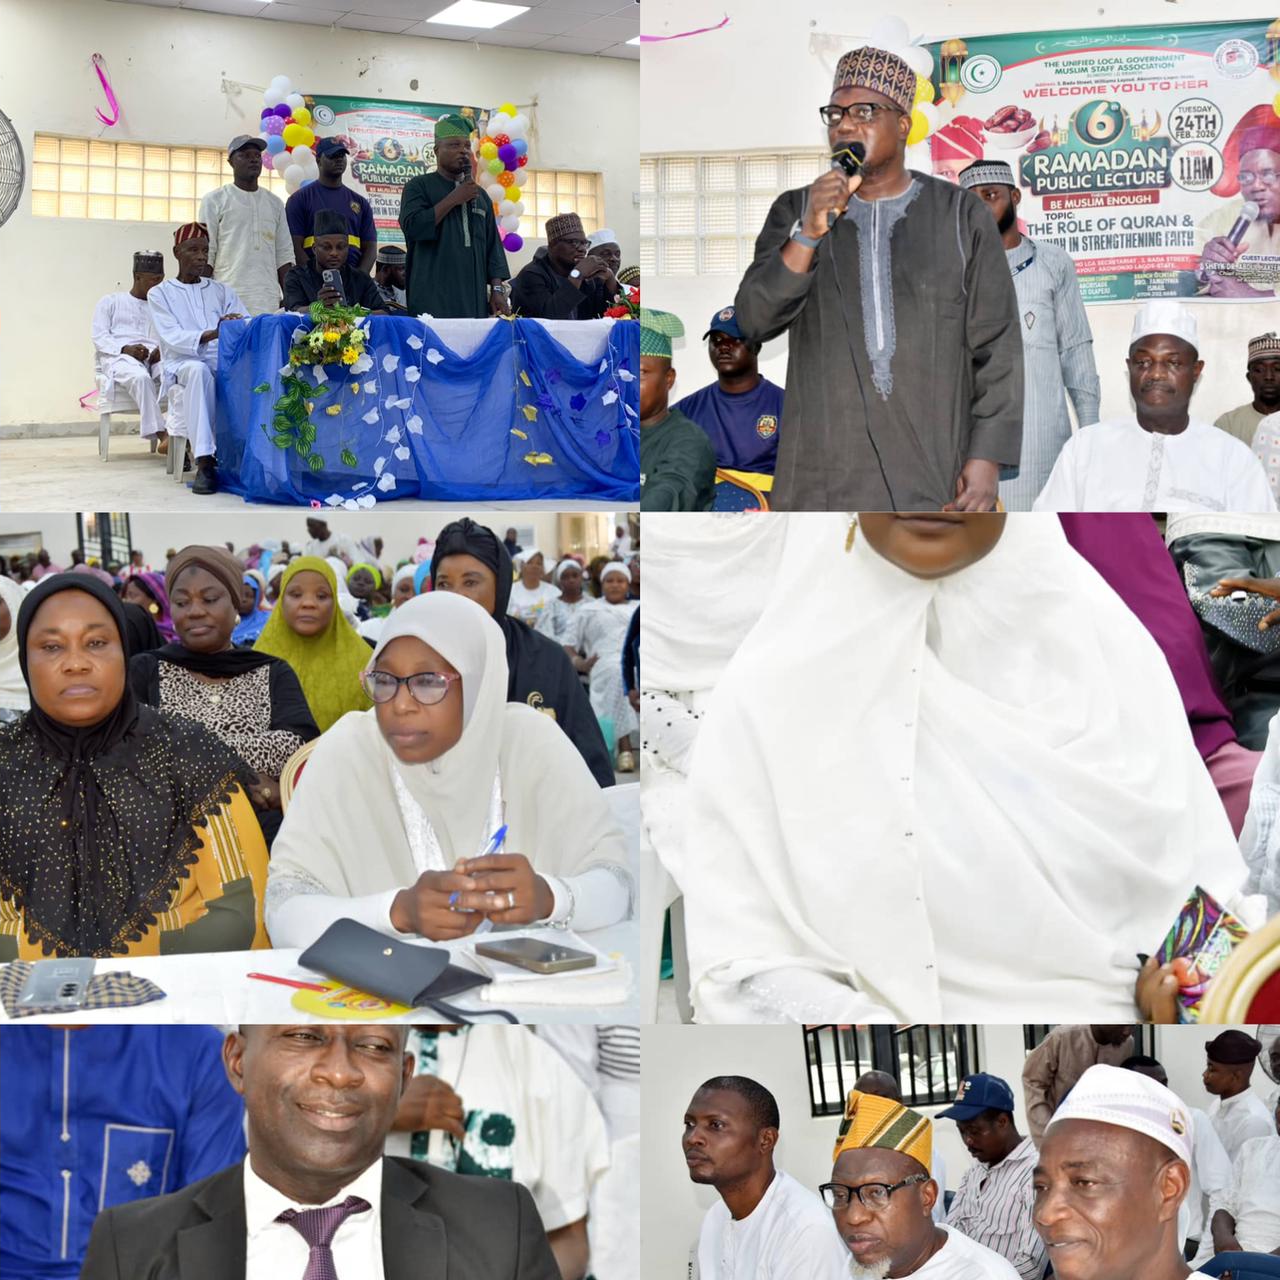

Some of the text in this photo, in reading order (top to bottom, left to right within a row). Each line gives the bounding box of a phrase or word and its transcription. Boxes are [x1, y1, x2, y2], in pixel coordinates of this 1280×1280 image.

[1044, 54, 1185, 69] THE UNIFIED LOCAL GOVERNMENT
[1055, 62, 1175, 75] MUSLIM STAFF ASSOCIATION
[1023, 80, 1209, 99] WELCOME YOU TO HER
[1178, 105, 1212, 113] TUESDAY
[1087, 101, 1116, 140] 6
[1175, 115, 1217, 131] 24TH
[1196, 130, 1216, 138] 2026
[1034, 148, 1167, 176] RAMADAN
[1179, 156, 1214, 181] 11AM
[359, 163, 424, 177] RAMADAN
[362, 174, 390, 183] PUBLIC
[1036, 170, 1165, 192] PUBLIC LECTURE
[375, 199, 393, 207] ROLE
[1050, 195, 1152, 210] BE MUSLIM ENOUGH
[1045, 212, 1075, 221] TOPIC:
[1026, 214, 1194, 236] THE ROLE OF QURAN &
[1069, 231, 1194, 253] IN STRENGTHENING FAITH
[1098, 258, 1137, 267] SECRETARIAT
